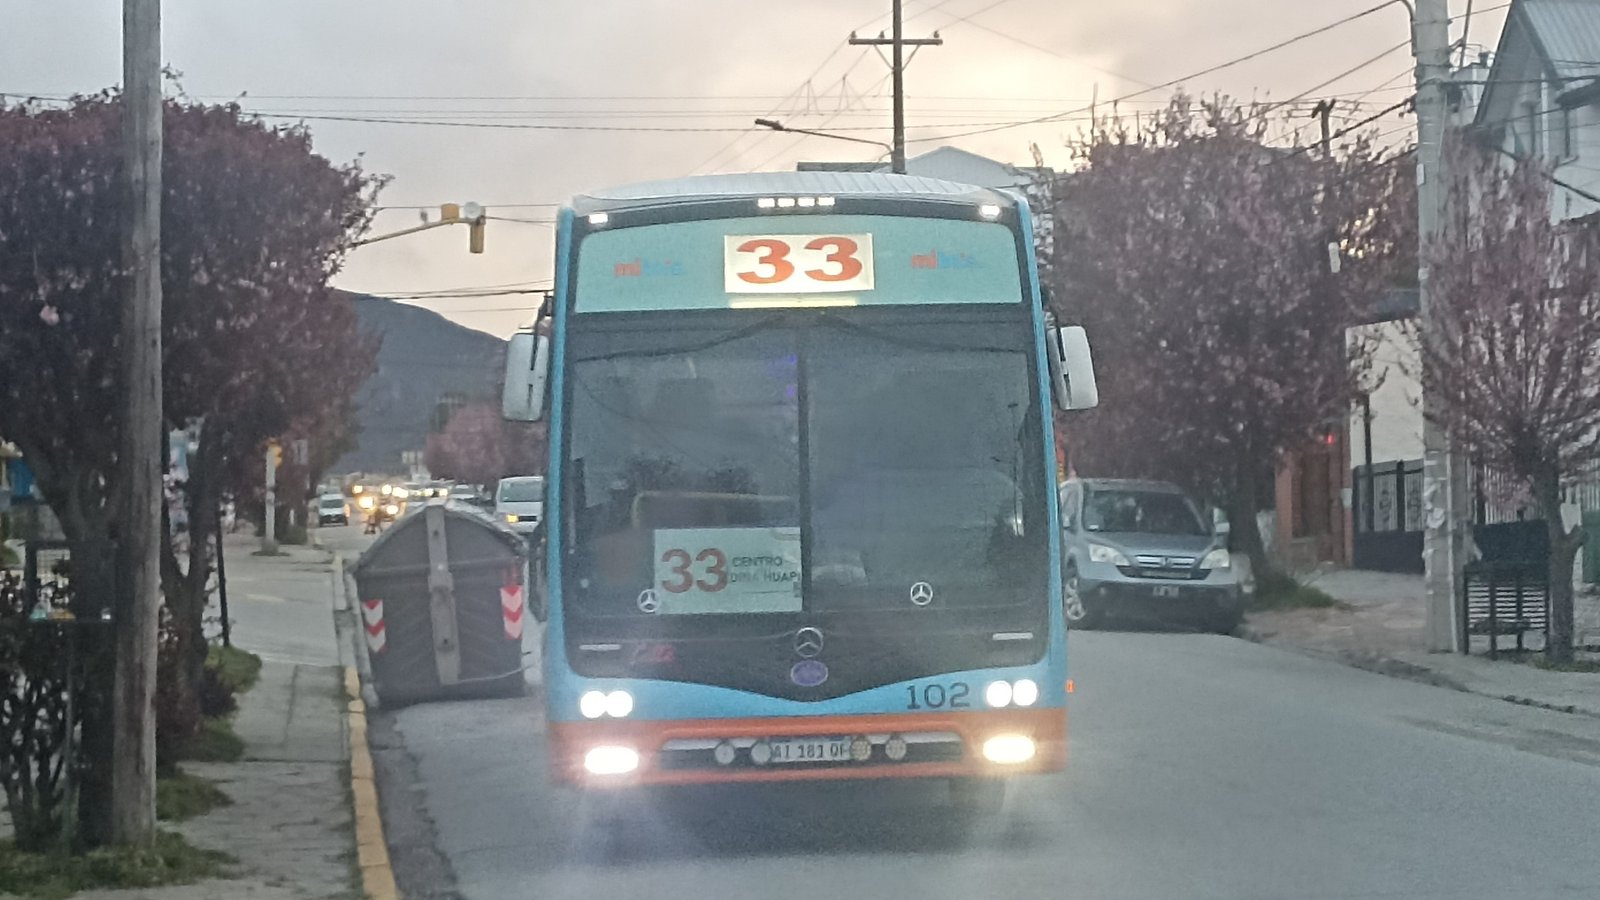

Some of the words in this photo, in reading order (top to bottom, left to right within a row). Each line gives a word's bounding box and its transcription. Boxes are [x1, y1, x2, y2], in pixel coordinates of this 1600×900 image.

[737, 234, 863, 285] 33
[661, 547, 729, 593] 33
[731, 555, 783, 568] CENTRO
[906, 682, 971, 710] 102
[798, 743, 824, 759] 181
